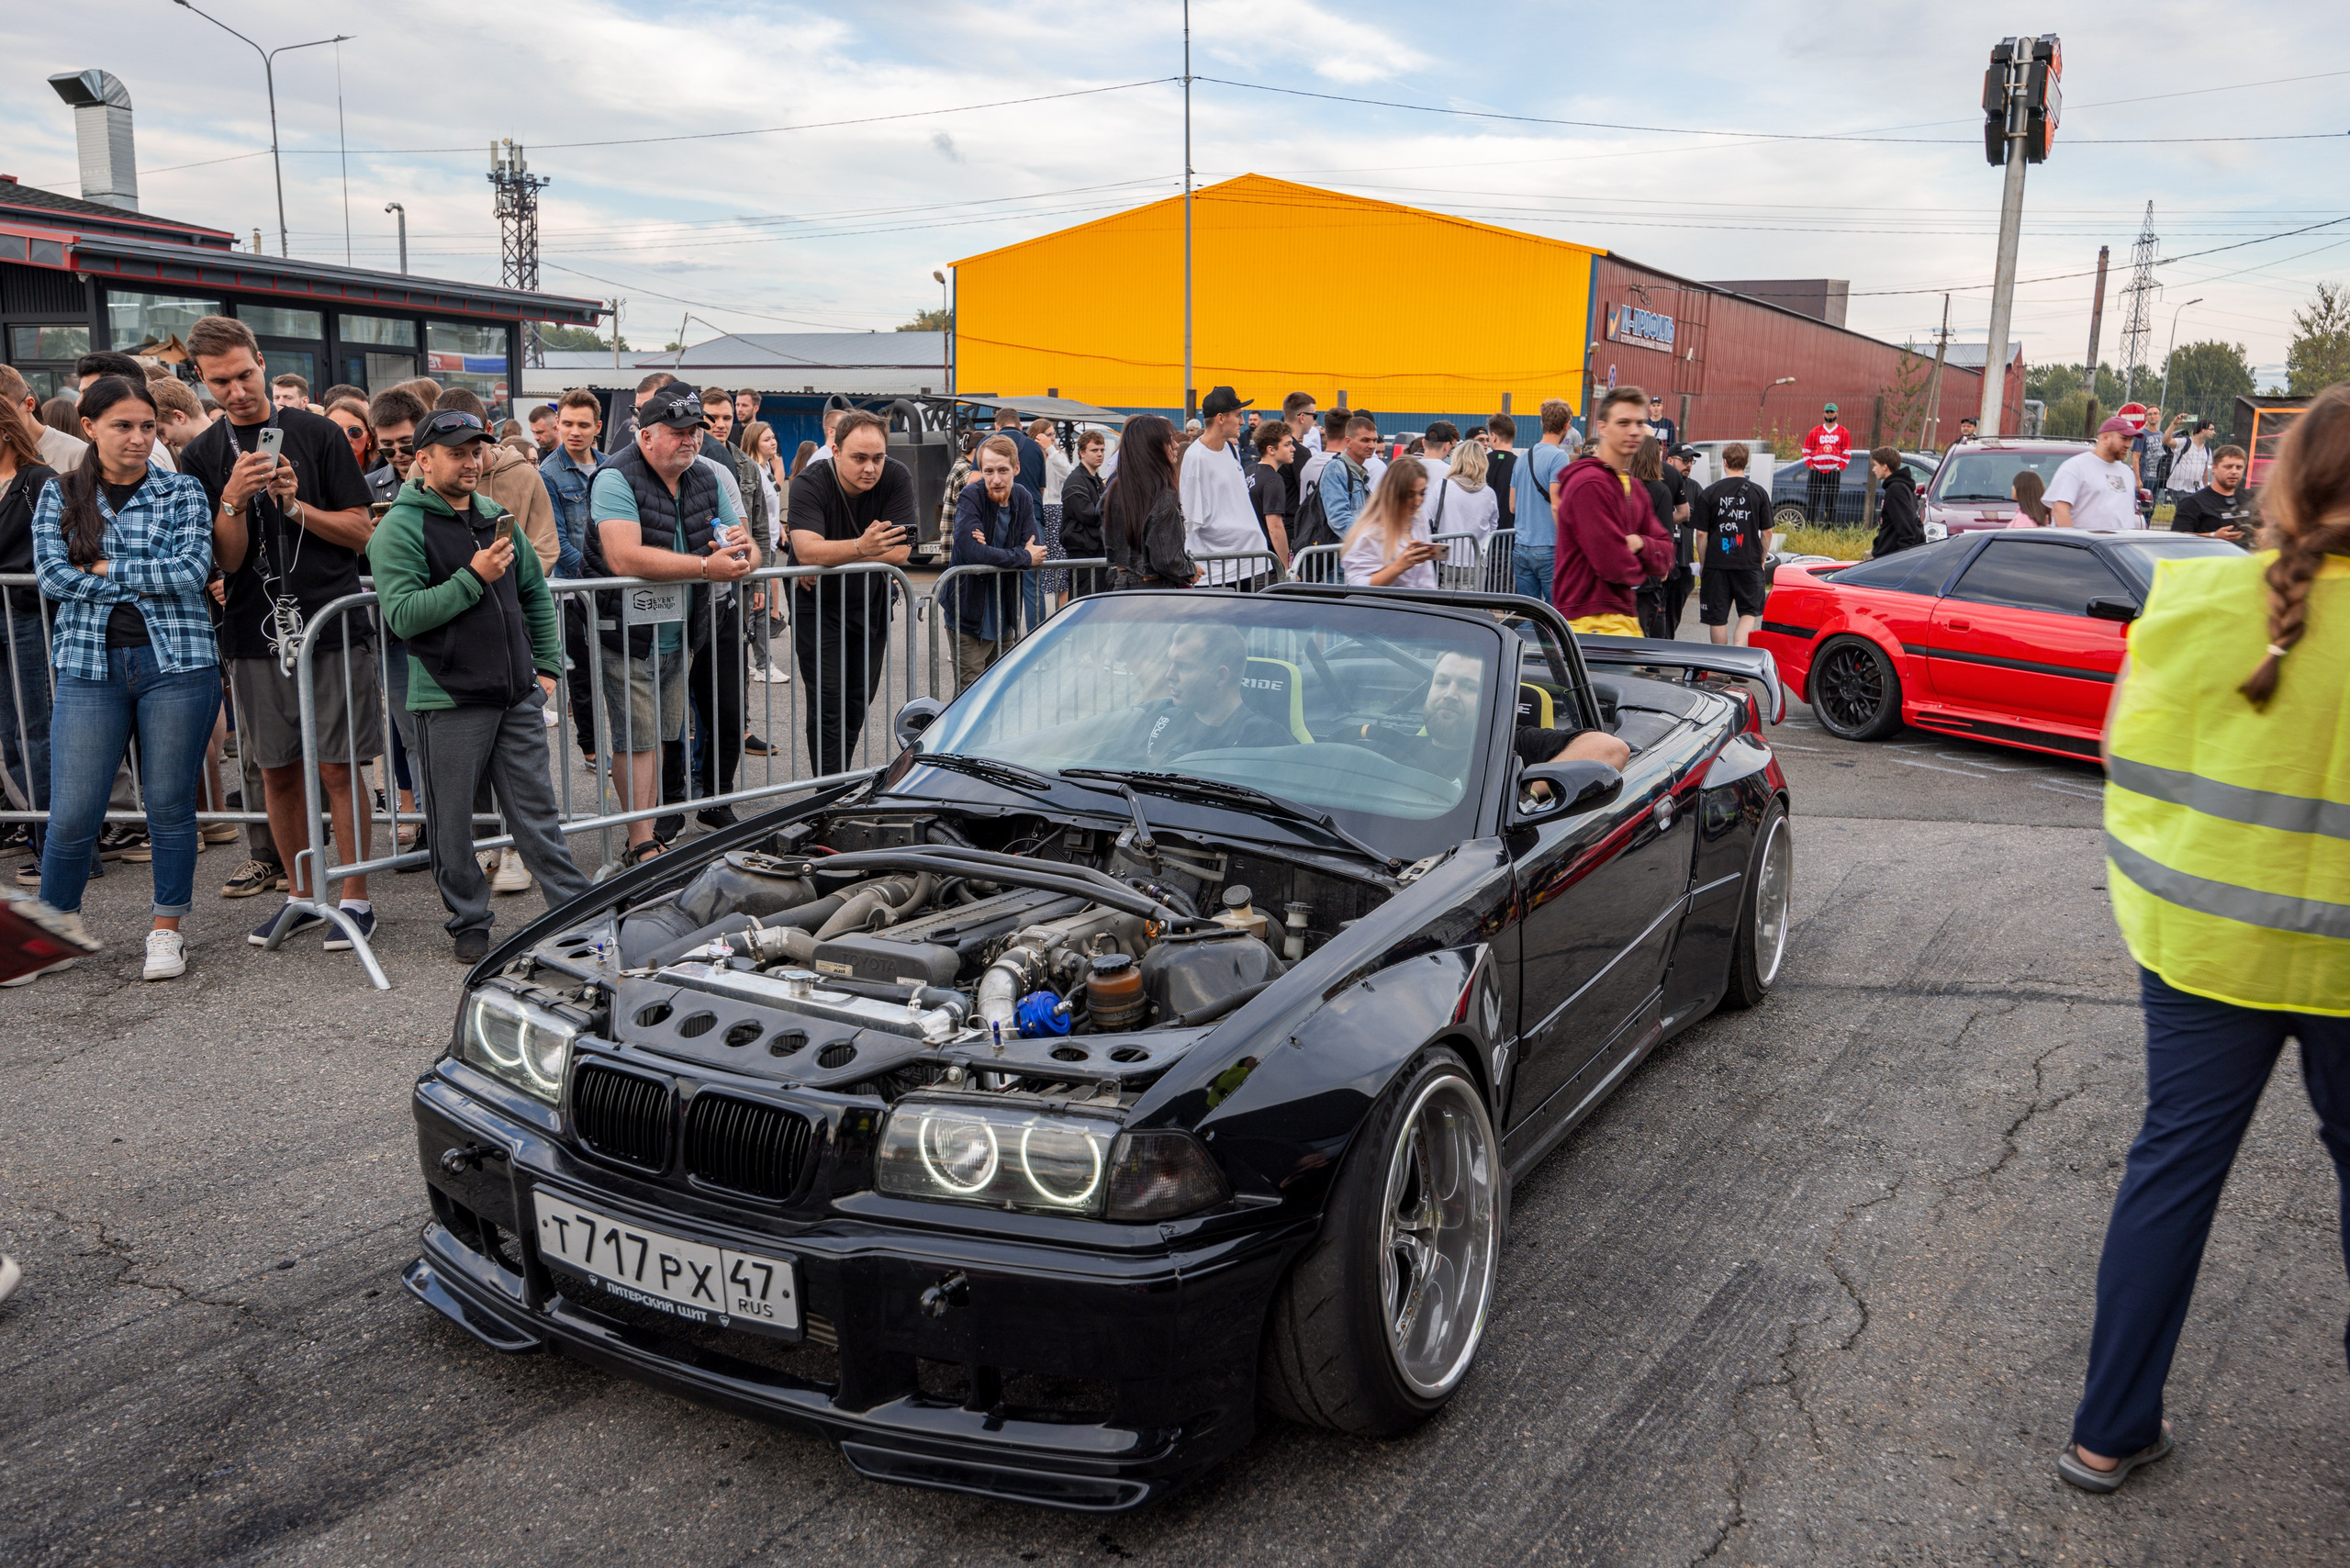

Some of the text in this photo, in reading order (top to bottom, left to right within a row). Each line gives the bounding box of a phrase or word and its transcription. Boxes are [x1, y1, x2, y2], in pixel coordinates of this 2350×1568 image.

[1620, 304, 1674, 343] М-ПРОФИЛЬ
[1818, 434, 1840, 444] СССР
[1719, 496, 1746, 510] NED
[1718, 508, 1751, 521] MNEY
[1718, 521, 1739, 532] FOR
[1721, 533, 1744, 554] BMW
[653, 602, 676, 610] GROUP
[1240, 678, 1283, 690] RIDE
[841, 952, 898, 973] TOYOTA
[730, 1258, 773, 1300] 47
[606, 1282, 708, 1323] ПИТЕРСКИЙ ЩИТ
[738, 1297, 773, 1318] RUS
